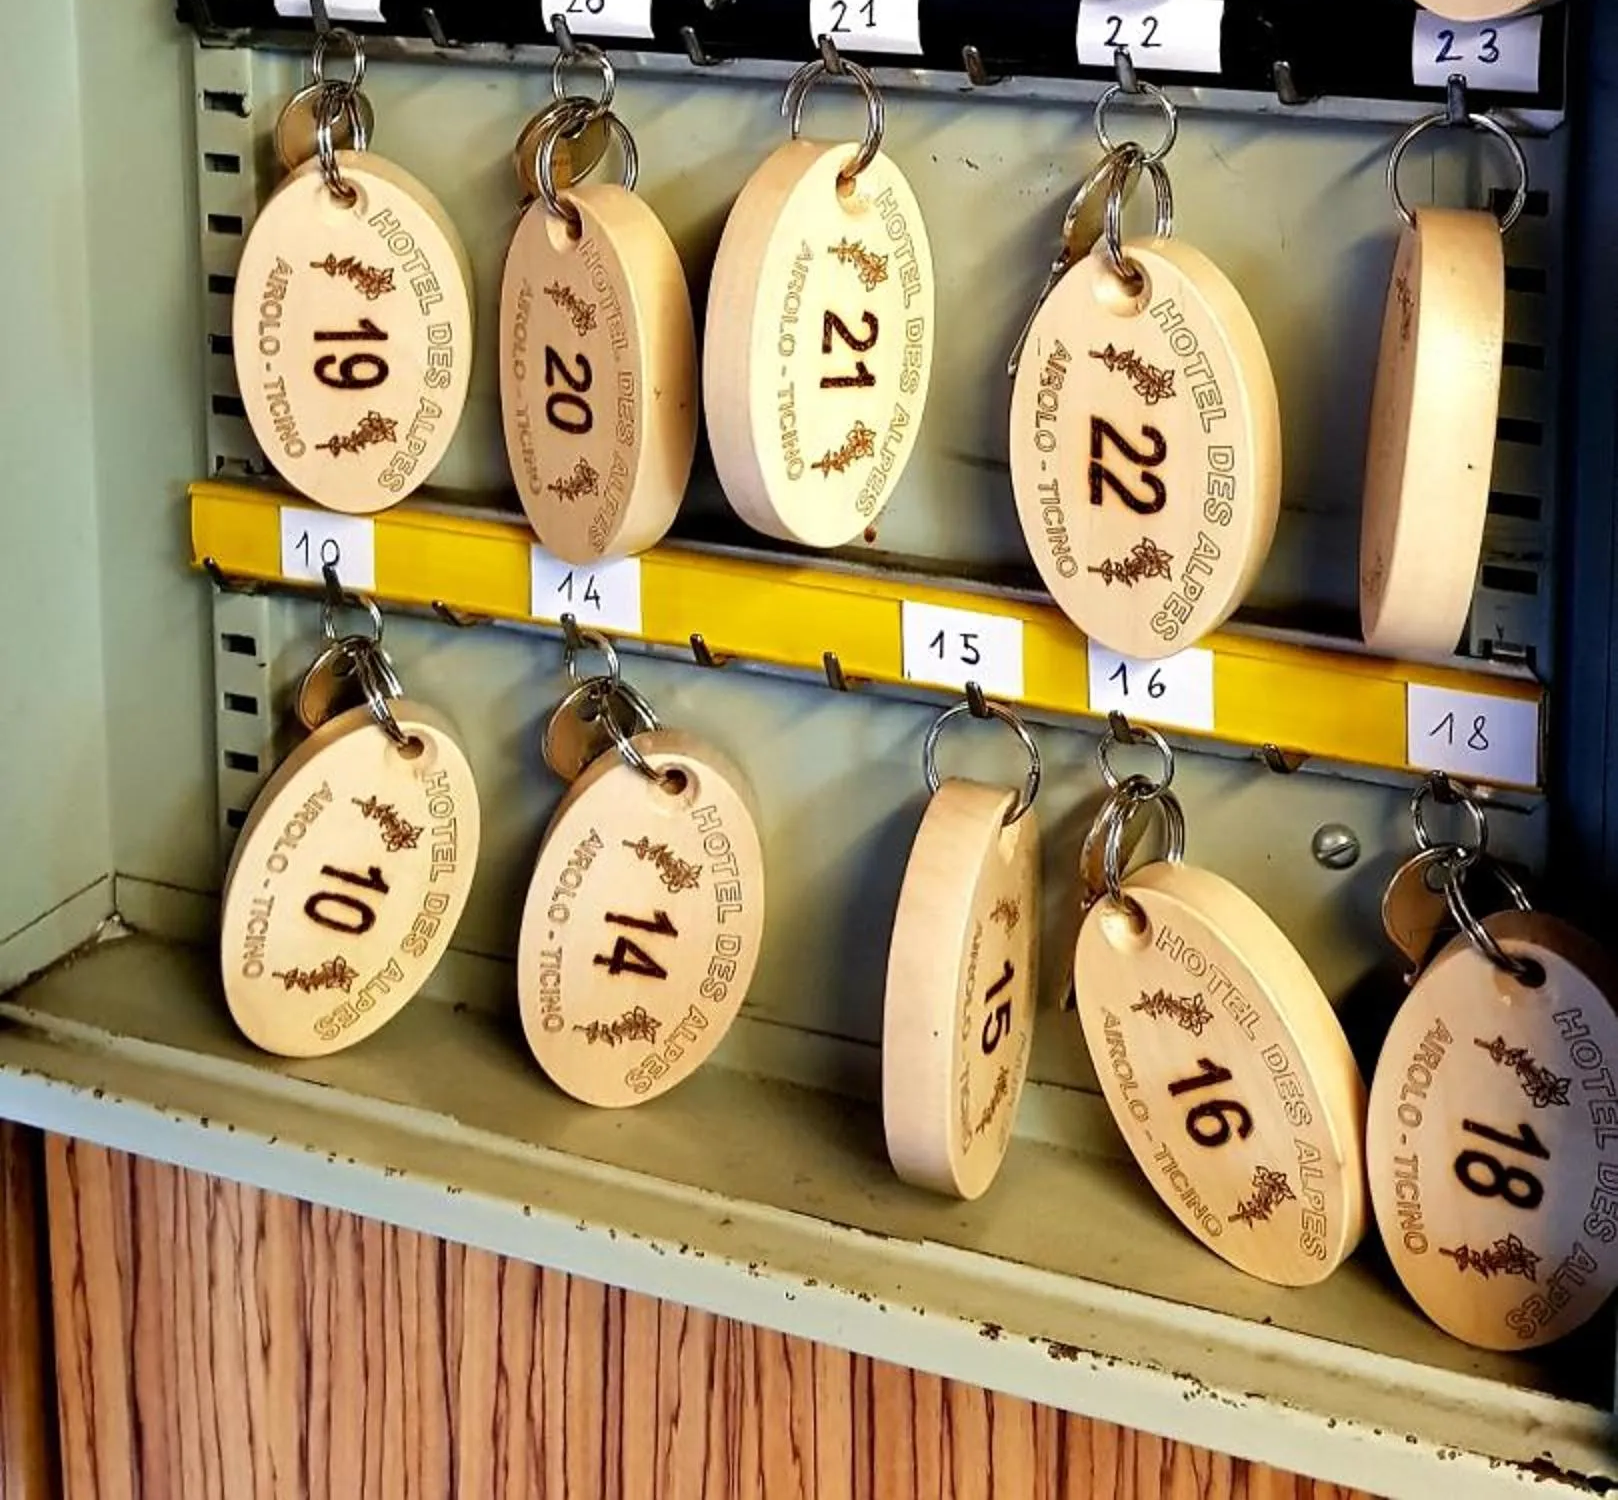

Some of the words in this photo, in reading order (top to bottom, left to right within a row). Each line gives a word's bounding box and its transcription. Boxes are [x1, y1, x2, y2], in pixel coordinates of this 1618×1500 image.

[1104, 15, 1162, 47] 22
[1435, 28, 1501, 63] 23
[368, 209, 444, 316] HOTEL
[876, 187, 922, 309] HOTEL
[260, 256, 293, 356] AIROLO
[778, 239, 813, 357] AIROLO
[313, 319, 389, 390] 19
[424, 323, 452, 389] DES
[544, 344, 593, 435] 20
[821, 310, 879, 389] 21
[900, 317, 924, 395] DES
[1035, 339, 1073, 451] AIROLO
[1150, 298, 1227, 433] HOTEL
[263, 376, 307, 459] TICINO
[377, 397, 442, 493] ALPES
[777, 382, 804, 482] TICINO
[856, 402, 910, 517] ALPES
[1088, 414, 1167, 515] 22
[1203, 445, 1234, 527] DES
[295, 531, 340, 567] 10
[1037, 482, 1078, 579] TICINO
[557, 571, 601, 609] 14
[1151, 532, 1220, 641] ALPES
[929, 630, 981, 666] 15
[1107, 661, 1167, 699] 16
[1428, 715, 1489, 751] 18
[266, 781, 333, 873] AIROLO
[423, 771, 457, 883] HOTEL
[692, 804, 742, 925] HOTEL
[304, 865, 390, 935] 10
[548, 827, 605, 924] AIROLO
[242, 895, 274, 979] TICINO
[401, 893, 449, 958] DES
[593, 910, 678, 980] 14
[699, 934, 741, 1003] DES
[313, 957, 405, 1041] ALPES
[539, 946, 564, 1033] TICINO
[981, 959, 1015, 1055] 15
[625, 1004, 709, 1095] ALPES
[1155, 925, 1260, 1041] HOTEL
[1261, 1043, 1312, 1127] DES
[1294, 1139, 1327, 1262] ALPES
[1397, 1017, 1454, 1127] AIROLO
[1552, 1008, 1618, 1152] HOTEL
[1100, 1007, 1149, 1123] AIROLO
[1151, 1142, 1224, 1238] TICINO
[1167, 1056, 1254, 1149] 16
[1393, 1153, 1428, 1256] TICINO
[1454, 1118, 1551, 1210] 18
[1583, 1162, 1618, 1244] DES
[1505, 1241, 1597, 1341] ALPES
